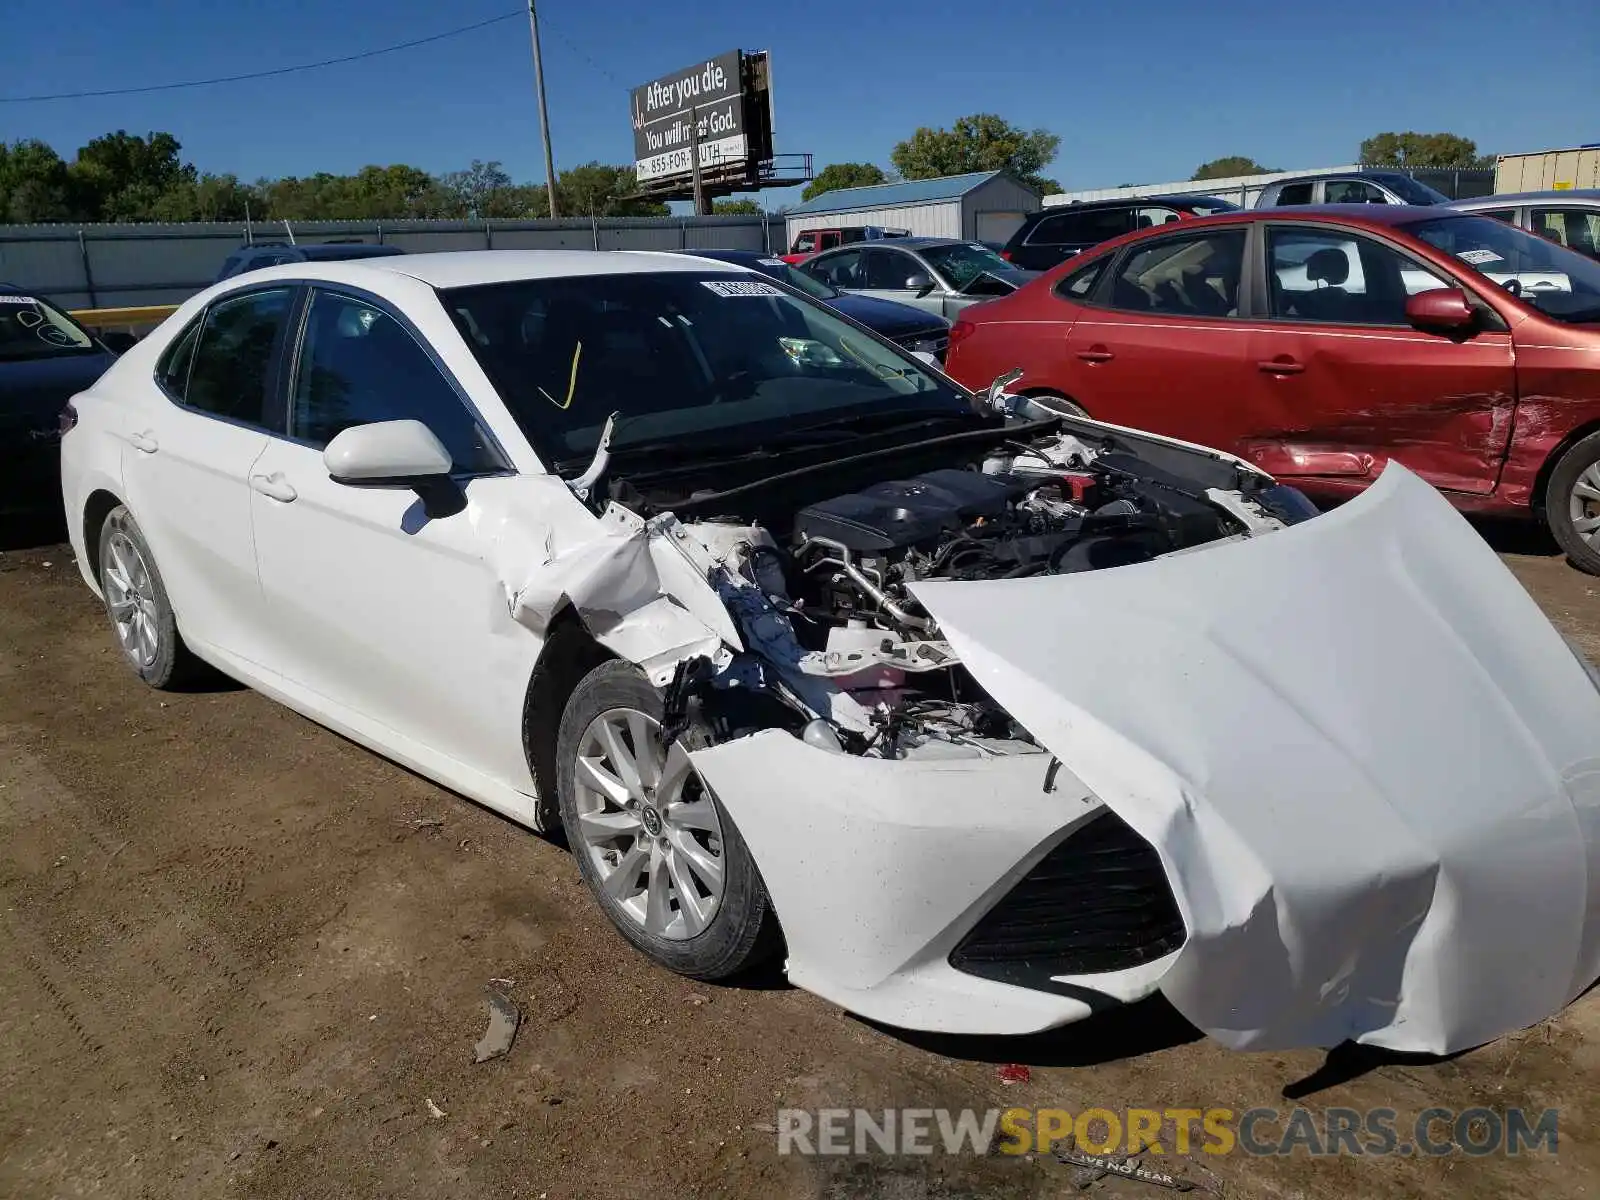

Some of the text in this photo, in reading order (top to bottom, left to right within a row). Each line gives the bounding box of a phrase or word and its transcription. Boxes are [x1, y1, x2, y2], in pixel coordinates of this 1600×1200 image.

[647, 61, 727, 111] After you die,
[646, 105, 736, 150] You will met God.
[651, 144, 720, 173] 855-FOR-UTH
[1107, 1162, 1132, 1174] NO
[1136, 1169, 1174, 1184] FEAR
